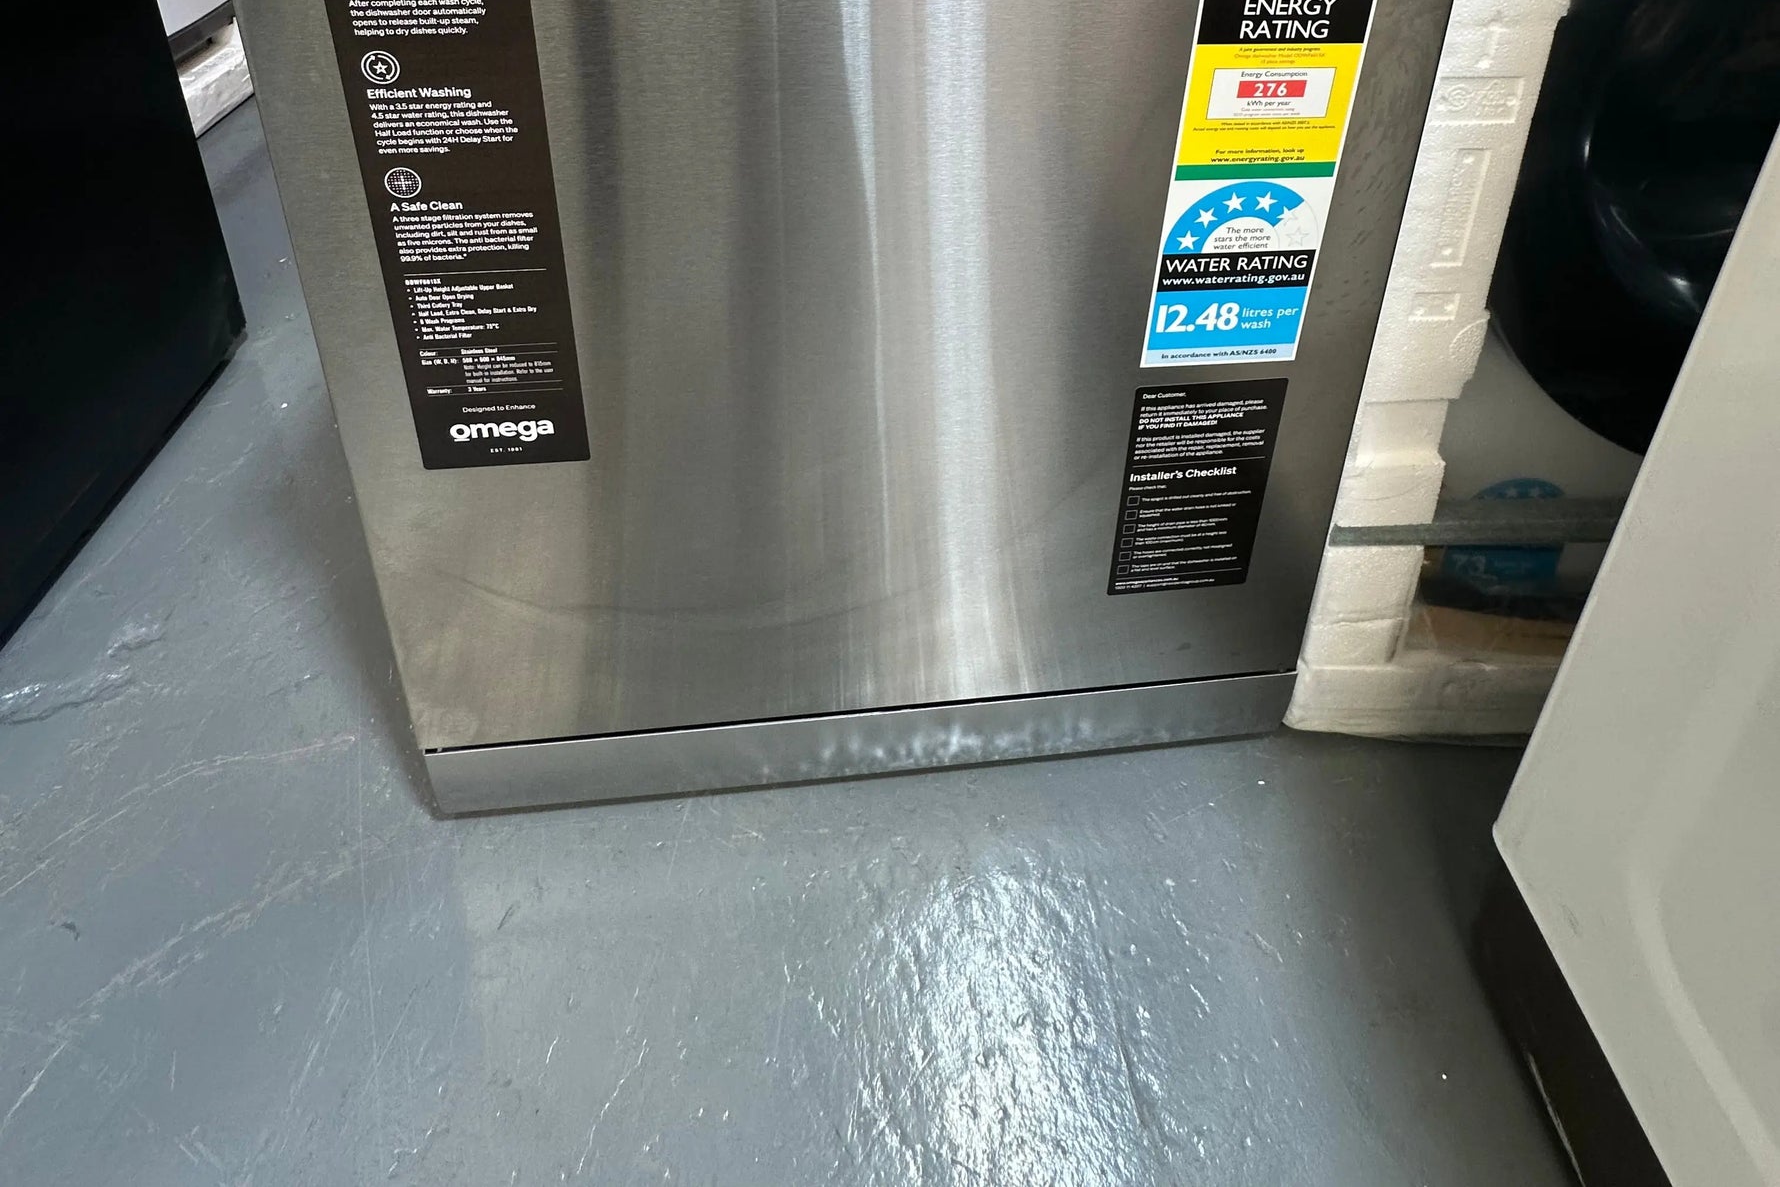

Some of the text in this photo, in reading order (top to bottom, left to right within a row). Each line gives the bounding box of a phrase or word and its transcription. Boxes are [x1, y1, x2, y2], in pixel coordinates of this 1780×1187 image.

[349, 0, 369, 7] After
[350, 7, 486, 17] the dishwasher door automatically
[388, 17, 417, 25] release
[418, 17, 450, 26] built-up
[354, 28, 384, 37] helping
[385, 27, 394, 35] to
[395, 27, 409, 36] dry
[410, 26, 436, 34] dishes
[1239, 19, 1330, 39] RATING
[1241, 70, 1308, 79] Energy Consumption
[367, 87, 472, 99] Efficient Washing
[1254, 83, 1287, 97] 276
[424, 103, 451, 111] energy
[452, 101, 475, 110] rating
[476, 100, 492, 108] and
[373, 120, 403, 128] delivers
[483, 126, 504, 134] when
[376, 138, 397, 146] cycle
[397, 137, 424, 146] begins
[459, 136, 481, 144] Delay
[1211, 154, 1305, 164] www.energyrating.gov.au
[390, 200, 463, 212] A Safe Clean
[420, 214, 441, 223] stage
[442, 213, 473, 221] filtration
[474, 212, 500, 221] system
[1226, 226, 1241, 234] The
[1234, 234, 1247, 242] the
[1213, 242, 1235, 250] water
[1166, 255, 1308, 272] WATER RATING
[1162, 273, 1305, 286] www.waterrating.gov.au
[1156, 302, 1240, 333] 12.48
[1242, 306, 1298, 318] litres per
[1241, 319, 1271, 329] wash
[462, 405, 496, 414] Designed
[505, 402, 536, 410] Enhance
[450, 420, 554, 442] omega
